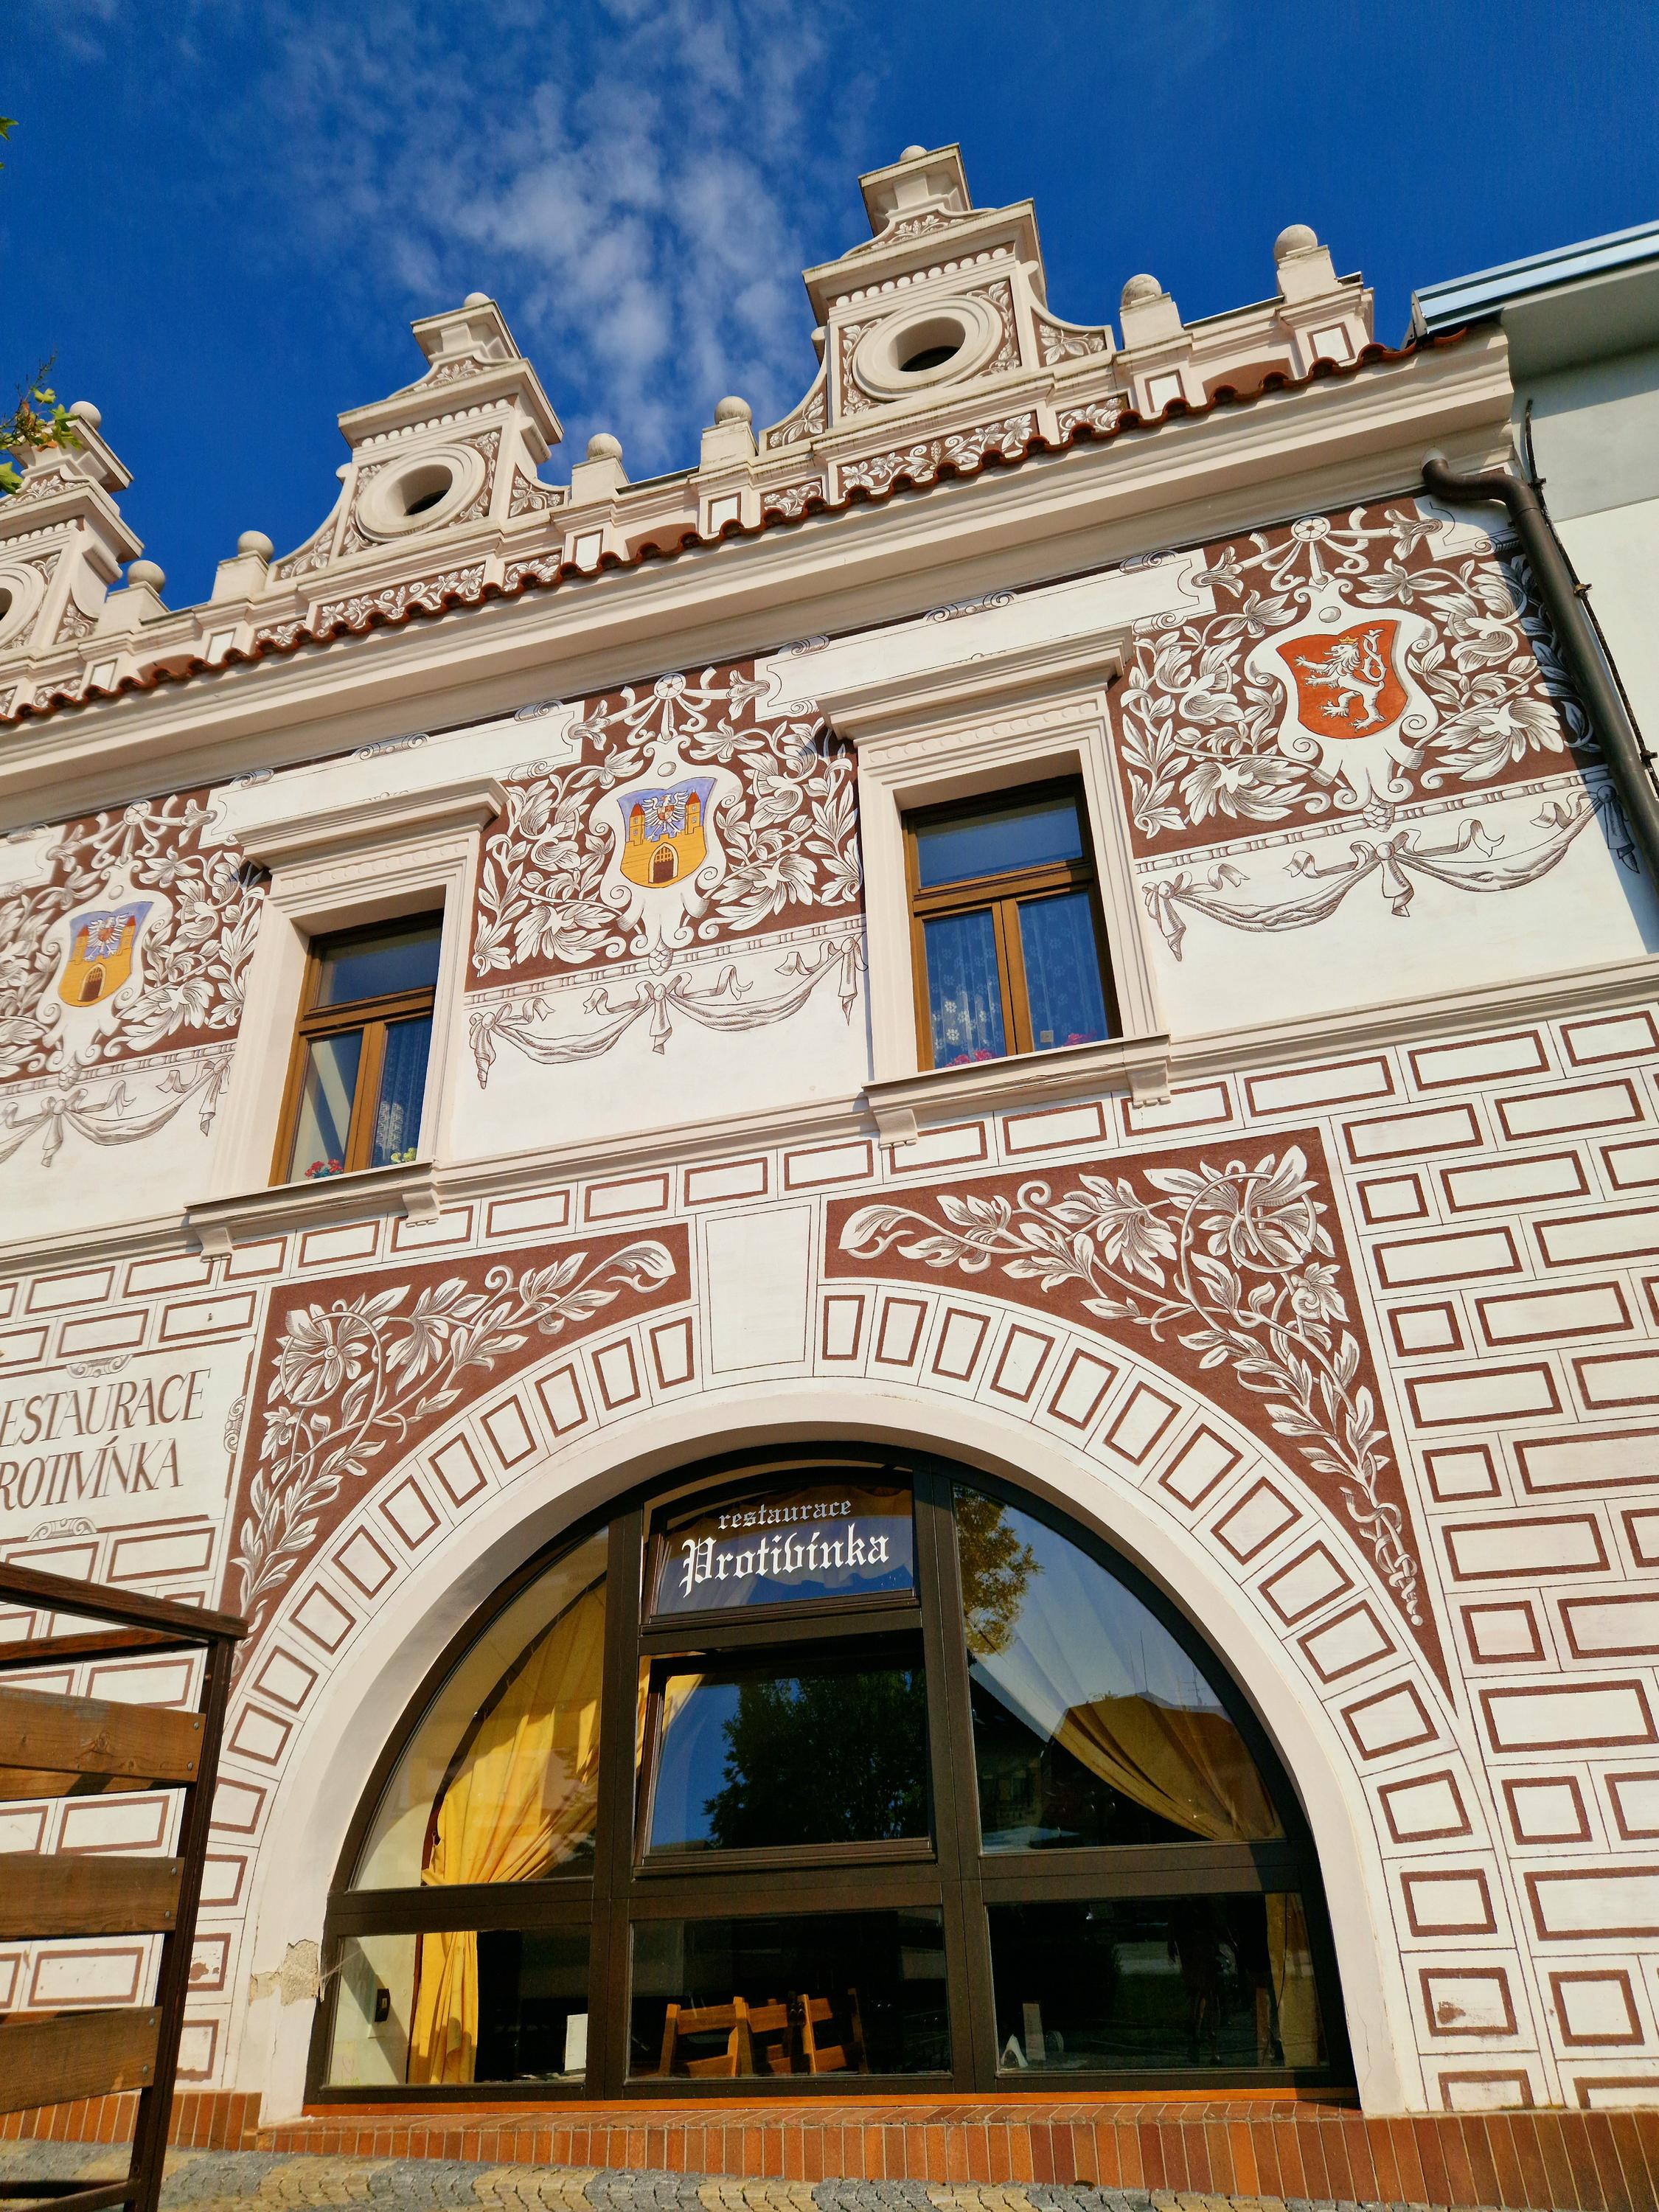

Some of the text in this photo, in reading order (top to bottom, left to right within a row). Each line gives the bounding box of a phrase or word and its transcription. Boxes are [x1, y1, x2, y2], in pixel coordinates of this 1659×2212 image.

[0, 1368, 212, 1447] ESTAURACE
[0, 1436, 183, 1511] ROTIVÍNKA
[717, 1500, 852, 1530] restaurace
[679, 1523, 889, 1598] Protivínka
